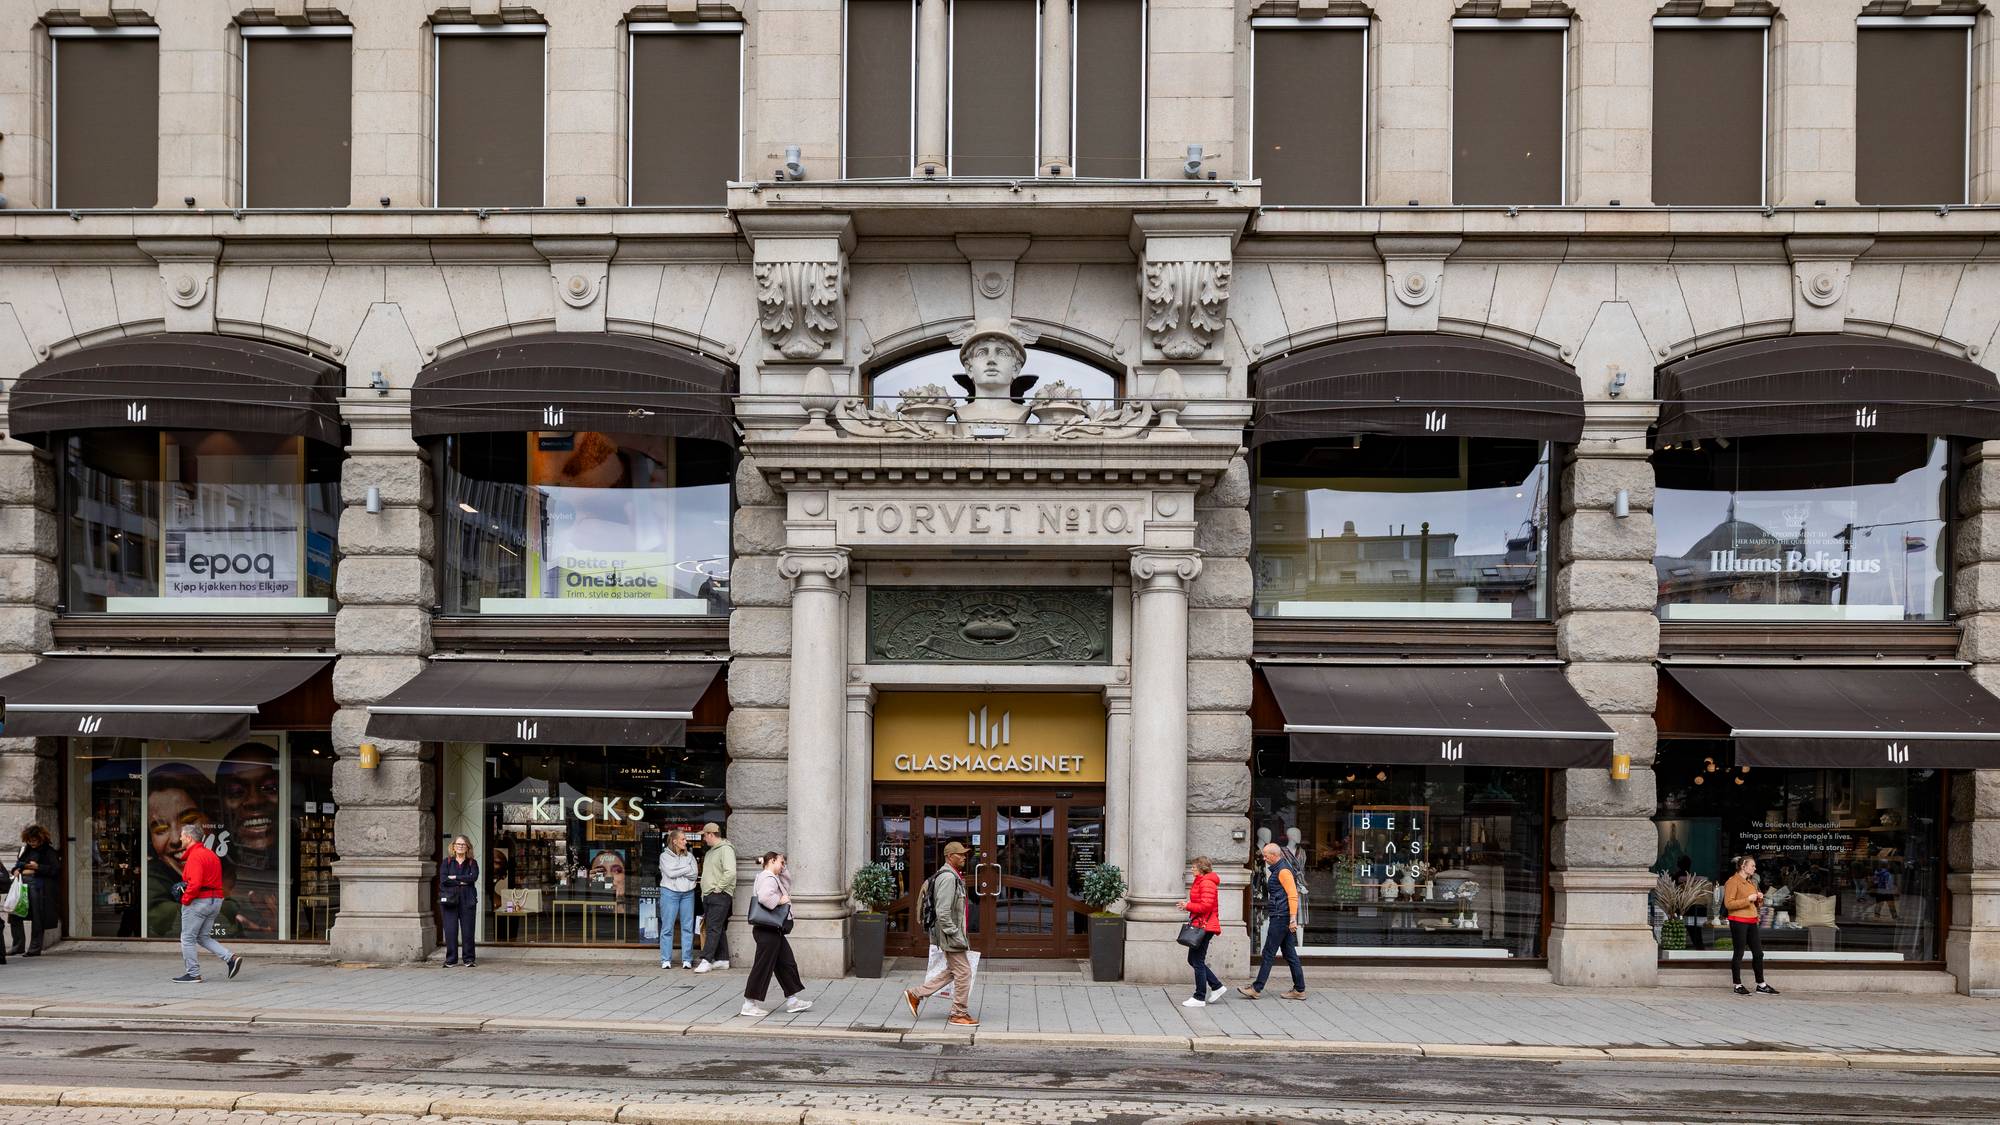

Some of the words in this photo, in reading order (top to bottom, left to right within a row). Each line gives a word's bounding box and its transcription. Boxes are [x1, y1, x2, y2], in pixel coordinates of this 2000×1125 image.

[849, 503, 1021, 534] TORVET
[189, 553, 274, 579] epoq
[566, 557, 608, 569] Dette
[612, 559, 626, 569] er
[1710, 550, 1782, 572] Illums
[1786, 550, 1881, 578] Bolighus
[566, 572, 658, 588] OneBlade
[174, 582, 197, 593] Kjøp
[199, 582, 237, 593] kjøkken
[239, 582, 257, 591] hos
[259, 582, 289, 593] Elkjøp
[566, 591, 587, 599] Trim,
[589, 591, 609, 600] style
[611, 592, 621, 600] og
[624, 591, 652, 599] barber
[894, 754, 1085, 773] GLASMAGASINET
[532, 796, 645, 821] KICKS
[1809, 821, 1841, 829] beautiful
[1740, 832, 1762, 840] things
[1803, 832, 1833, 840] people's
[880, 847, 905, 856] 1019
[1761, 844, 1781, 852] every
